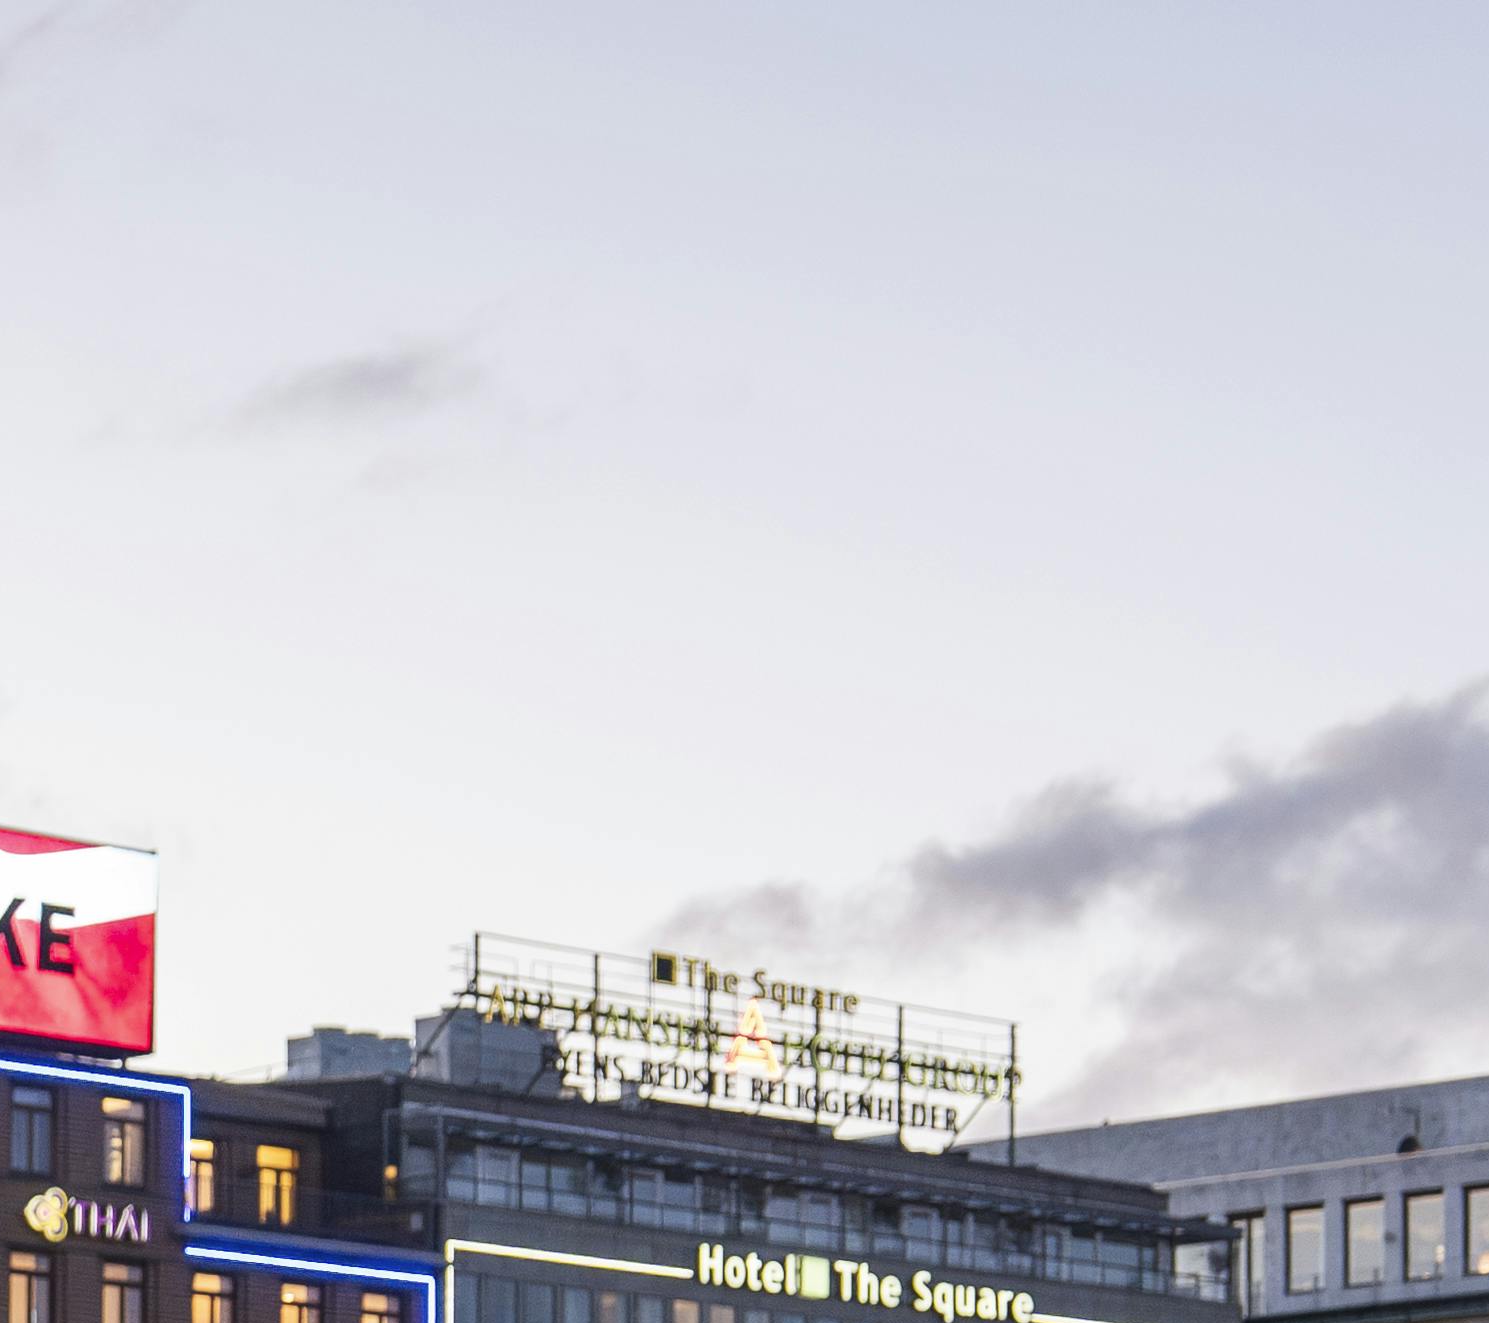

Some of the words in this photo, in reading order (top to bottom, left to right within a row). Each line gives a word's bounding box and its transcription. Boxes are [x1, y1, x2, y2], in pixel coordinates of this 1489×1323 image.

[684, 957, 737, 994] The
[754, 967, 861, 1015] Square
[642, 1060, 737, 1099] BEDSTE
[751, 1077, 959, 1132] BELIGGENHEDER
[71, 1199, 149, 1244] THAI
[697, 1241, 801, 1296] Hotel
[832, 1258, 901, 1310] The
